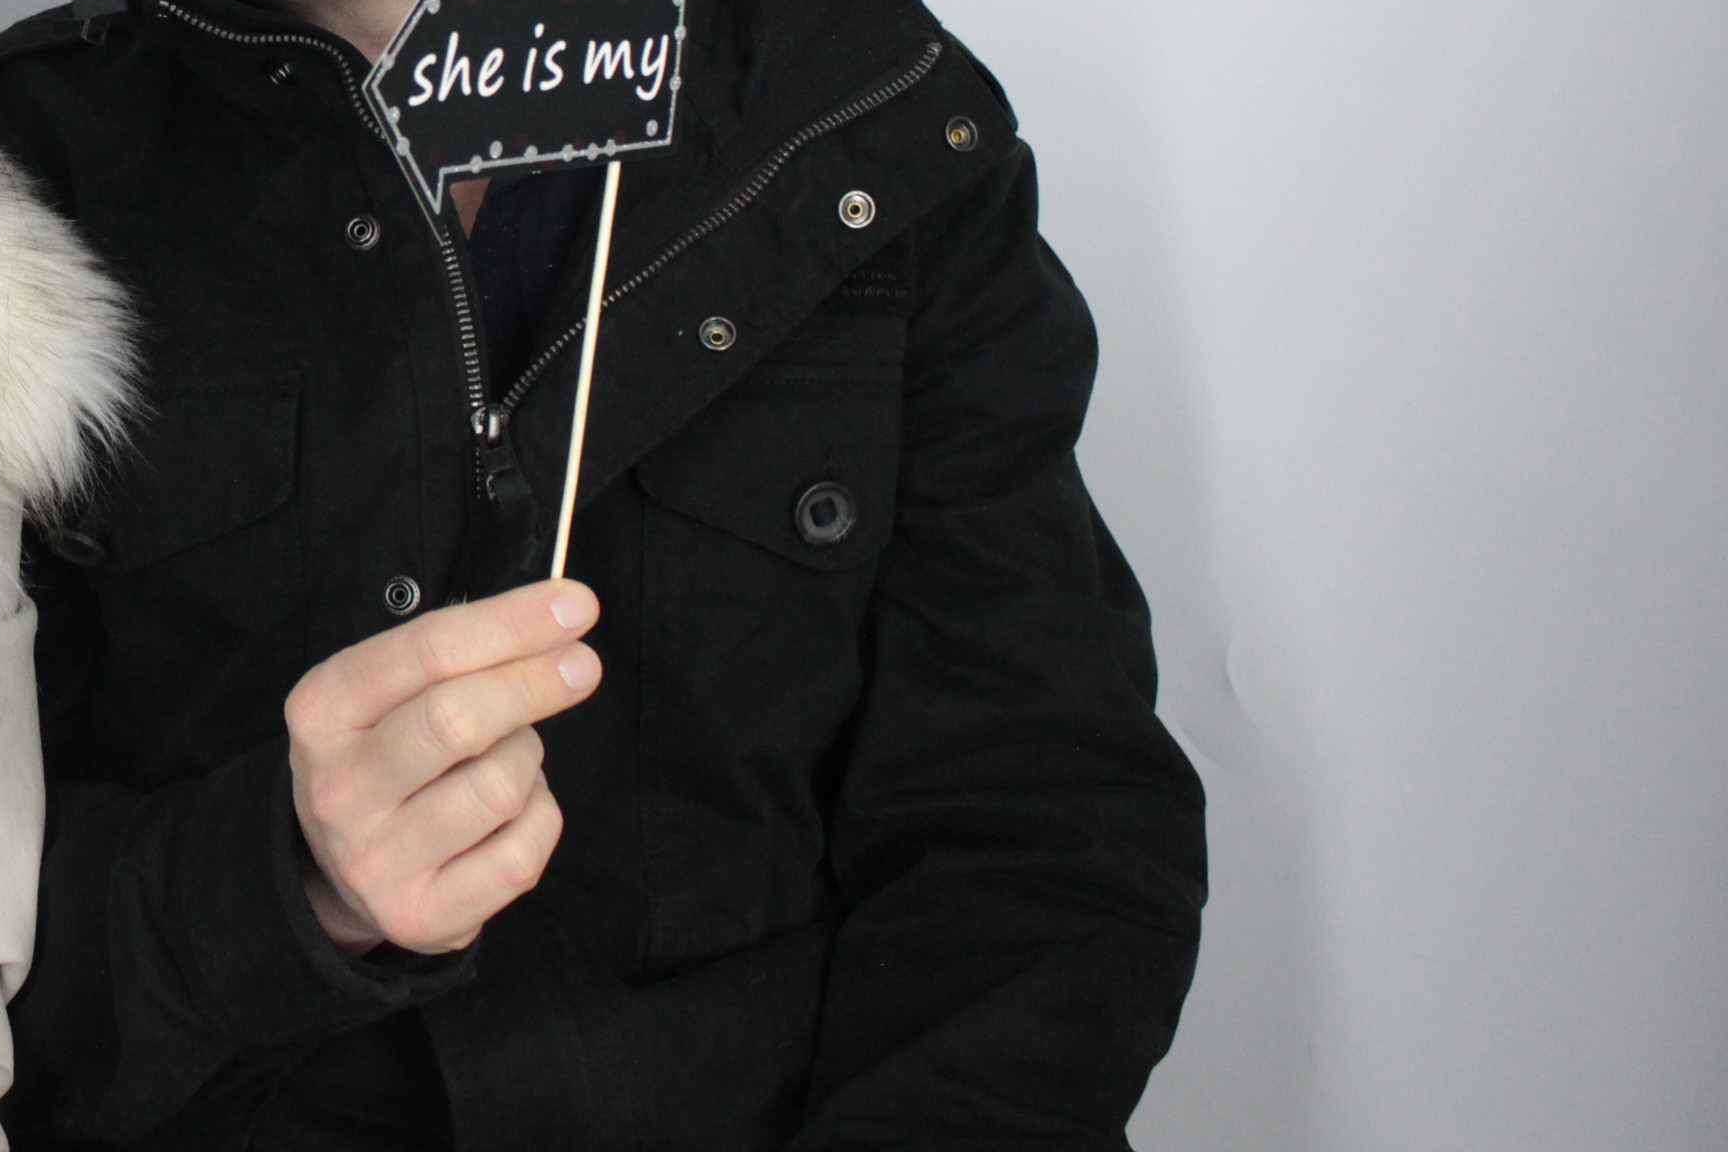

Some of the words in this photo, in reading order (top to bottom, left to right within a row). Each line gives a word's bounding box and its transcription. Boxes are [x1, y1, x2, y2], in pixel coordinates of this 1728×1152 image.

[408, 31, 505, 107] she
[522, 22, 567, 93] is
[583, 34, 669, 101] my
